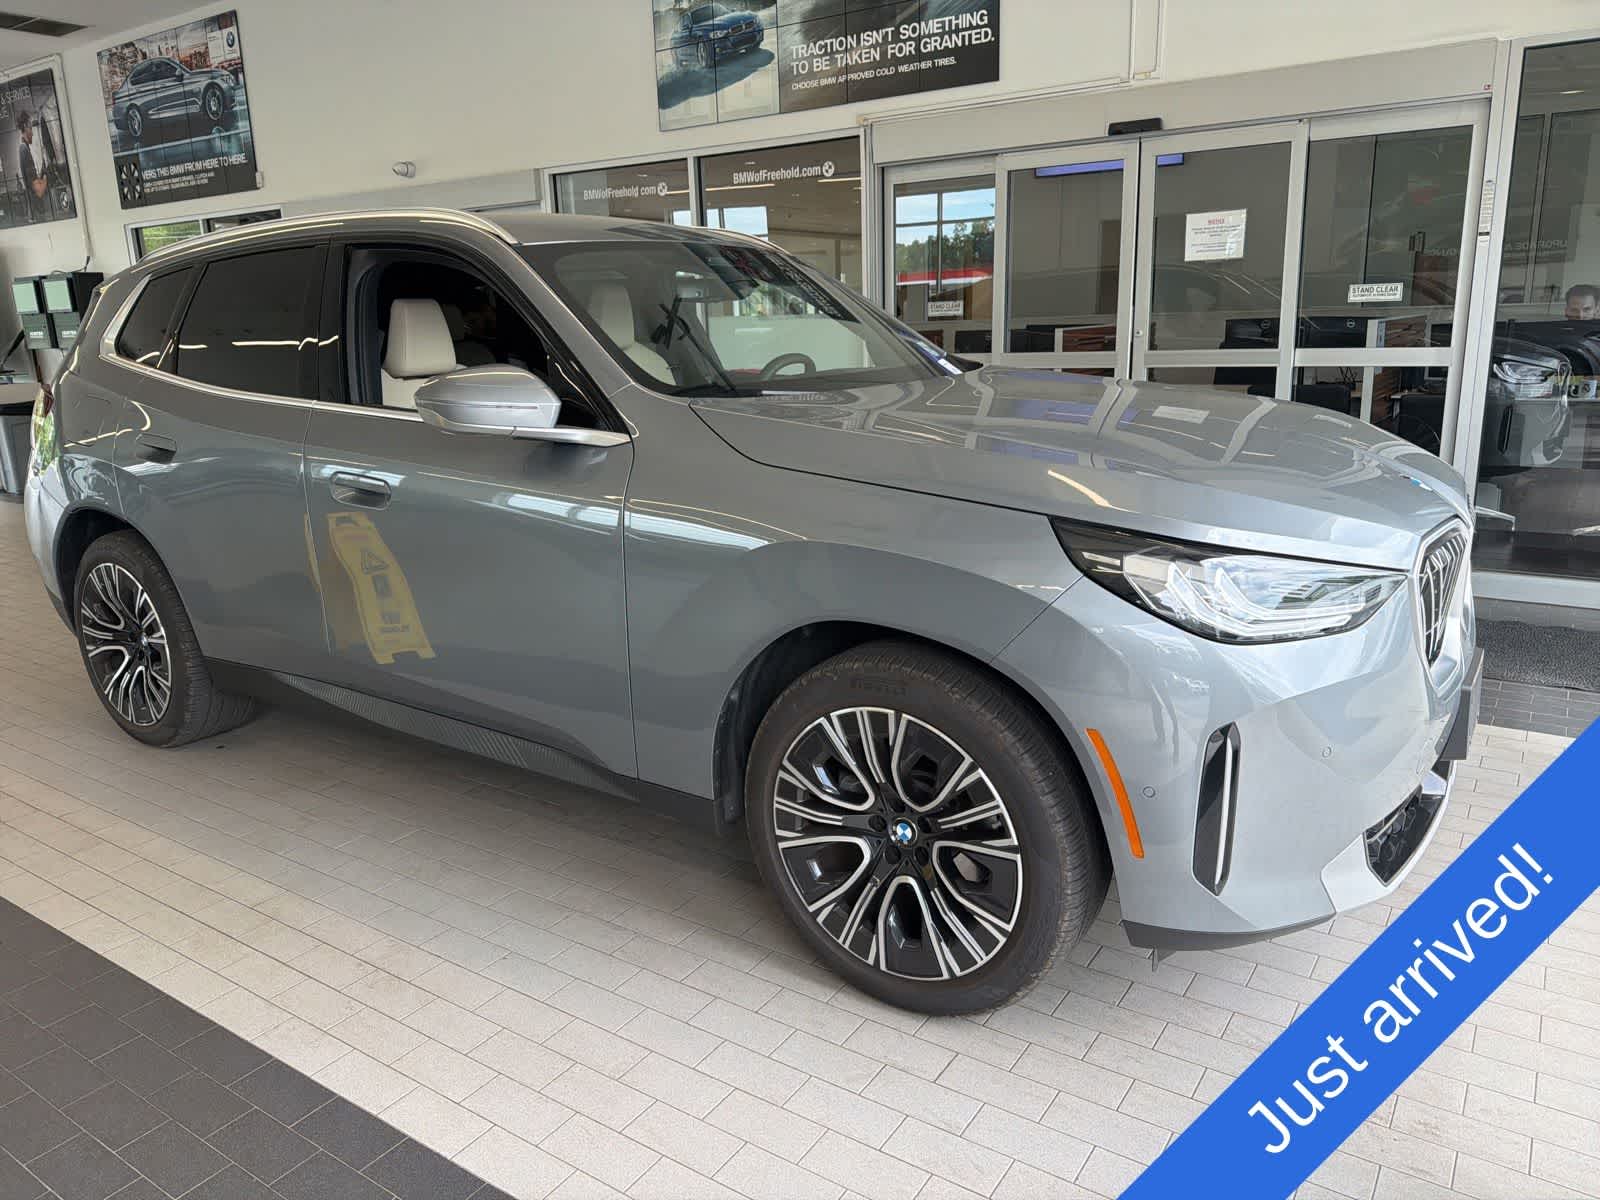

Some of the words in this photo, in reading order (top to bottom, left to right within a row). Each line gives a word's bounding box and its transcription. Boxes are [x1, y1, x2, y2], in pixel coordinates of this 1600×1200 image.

[791, 34, 857, 59] TRACTION
[860, 27, 895, 47] ISN'T
[899, 9, 988, 40] SOMETHING
[791, 60, 808, 75] TO
[813, 56, 831, 72] BE
[834, 47, 880, 68] TAKEN
[887, 41, 916, 59] FOR
[920, 27, 995, 53] GRANTED.
[791, 79, 820, 90] CHOOSE
[820, 76, 837, 85] BMW
[875, 66, 895, 76] COLD
[897, 60, 933, 73] WEATHER
[933, 56, 957, 67] TIRES.
[170, 163, 185, 176] BMW
[185, 160, 202, 172] FROM
[202, 157, 219, 170] HERE
[219, 156, 229, 167] TO
[733, 165, 821, 184] BMWofFreehold.com
[583, 185, 657, 200] BMWofFreeholdcom
[1352, 286, 1375, 294] STAND
[1375, 285, 1399, 293] CLEAR
